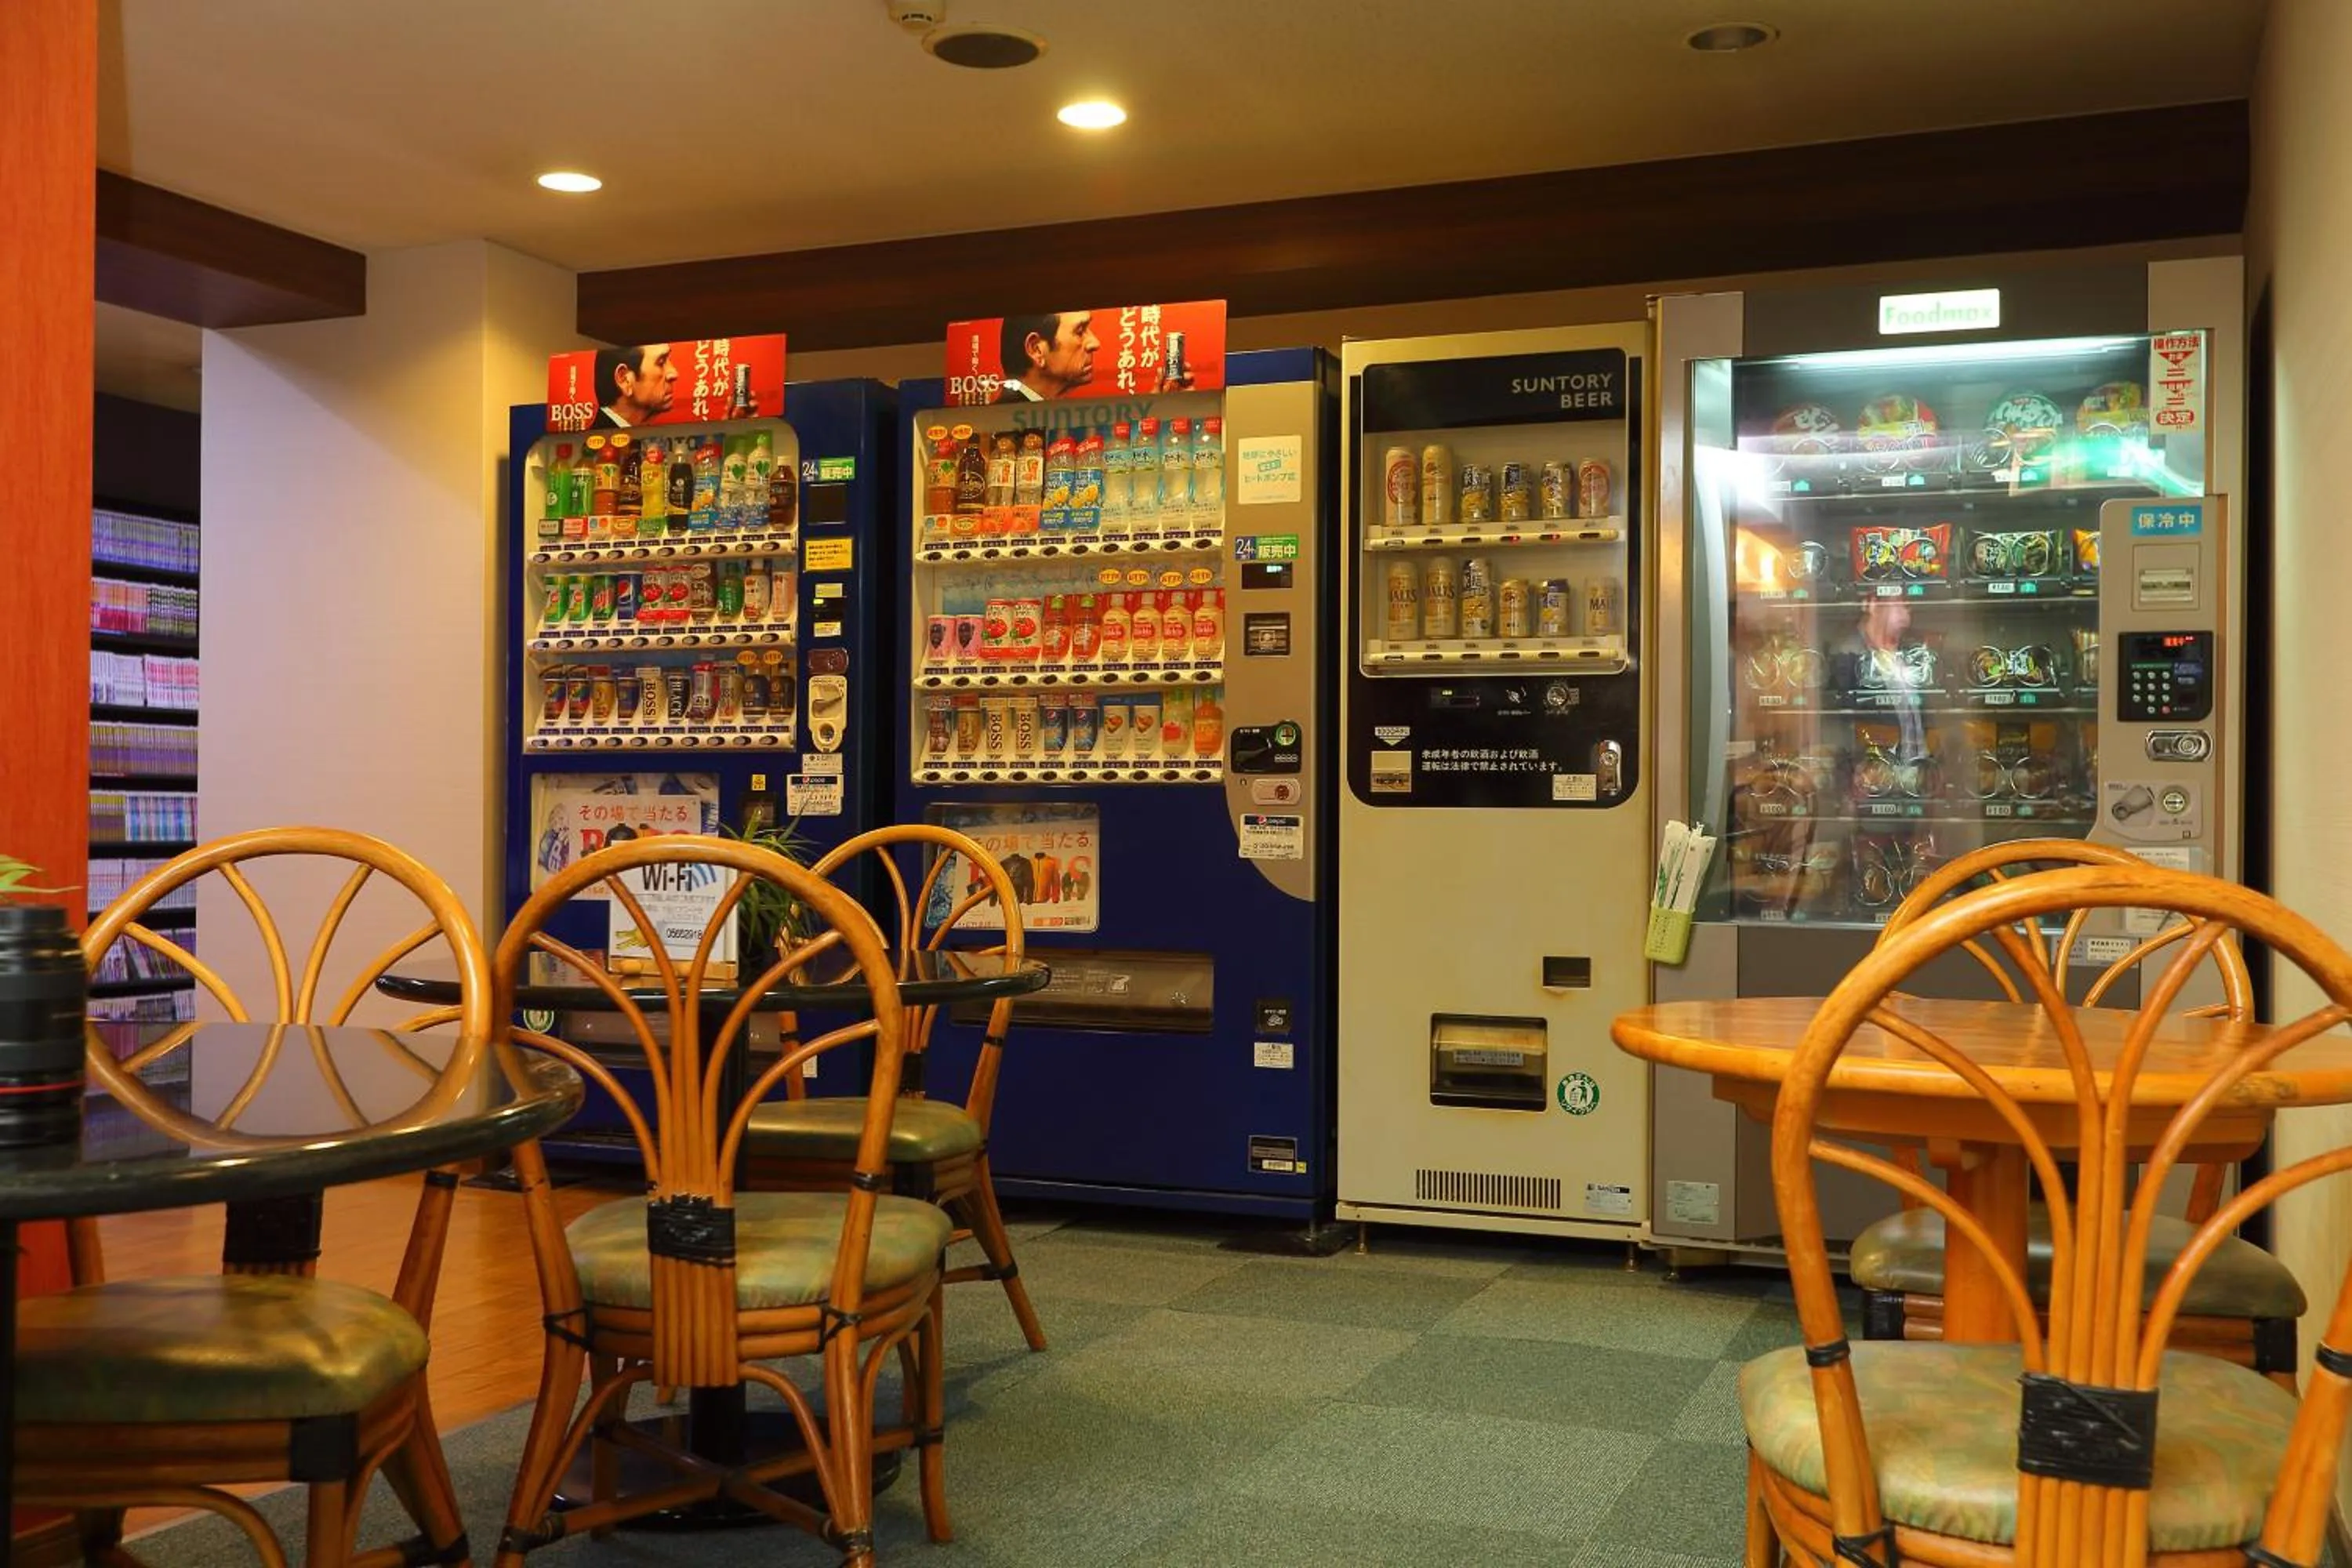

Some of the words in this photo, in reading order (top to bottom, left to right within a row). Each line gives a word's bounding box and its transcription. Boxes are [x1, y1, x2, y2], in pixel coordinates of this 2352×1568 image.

[1886, 299, 1992, 325] Foodmax
[1140, 305, 1161, 368] 時代が
[712, 338, 731, 397] 時代が
[950, 374, 1000, 394] BOSS
[1512, 373, 1613, 394] SUNTORY
[551, 401, 594, 422] BOSS
[1561, 391, 1613, 408] BEER
[1012, 401, 1154, 430] SUNTORY
[2138, 512, 2196, 529] 保冷中
[1258, 543, 1297, 559] 販売中
[645, 682, 656, 716] BOSS
[991, 713, 1003, 750] BOSS
[1020, 713, 1032, 750] BOSS
